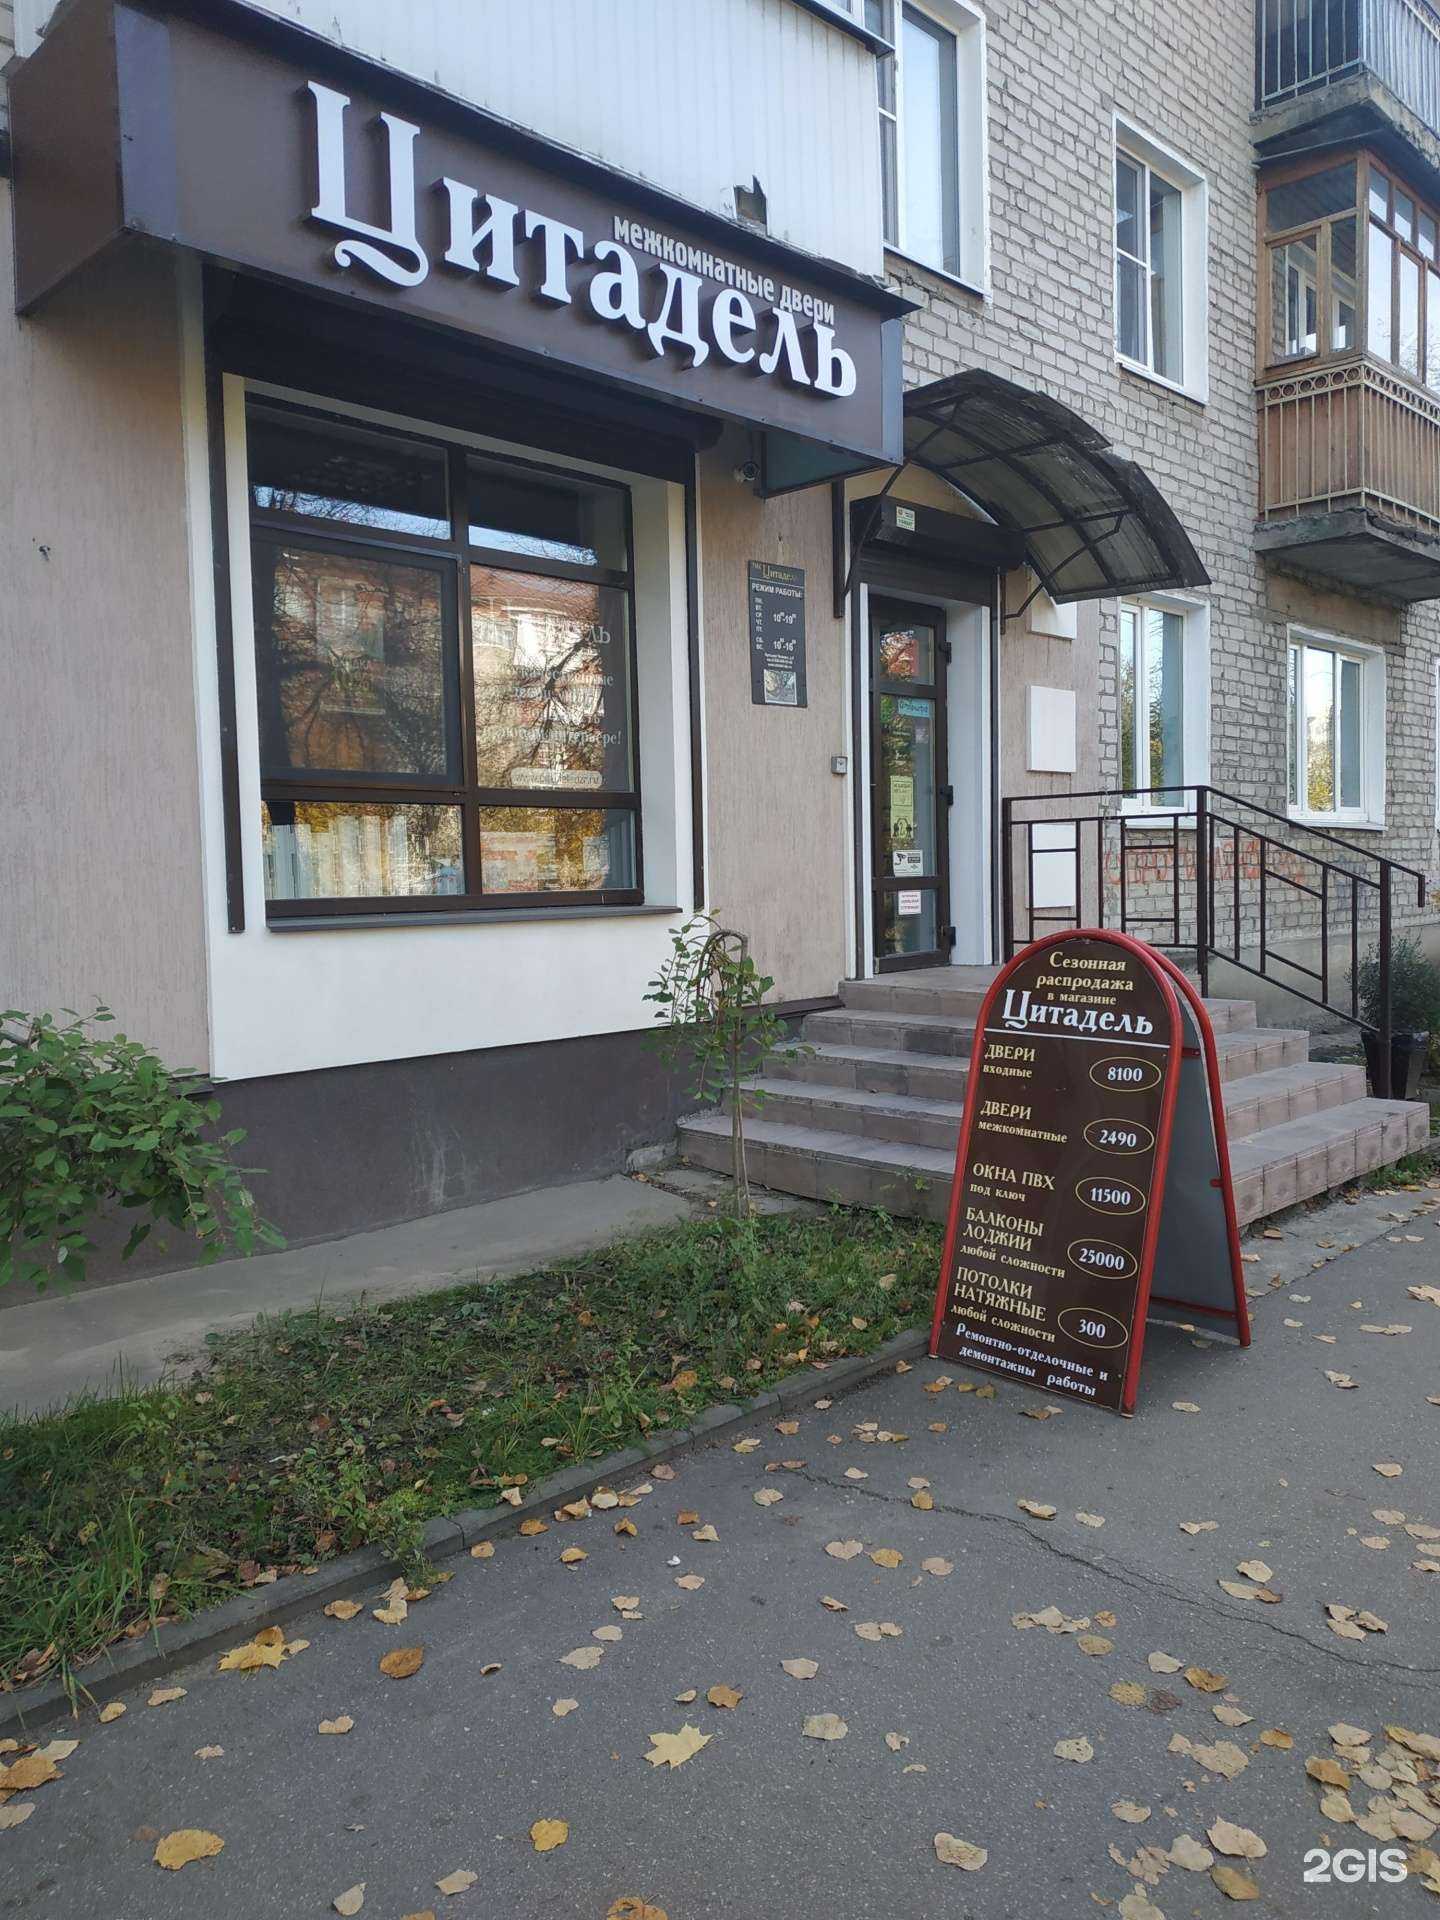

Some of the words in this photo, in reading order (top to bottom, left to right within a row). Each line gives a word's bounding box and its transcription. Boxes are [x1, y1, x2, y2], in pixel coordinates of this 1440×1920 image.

[306, 80, 857, 398] Цитадель
[613, 215, 775, 301] межкомнатные
[780, 285, 835, 325] двери
[1049, 951, 1126, 972] Сезонная
[1036, 974, 1134, 991] распродажа
[1047, 992, 1054, 1001] в
[1059, 993, 1116, 1006] магазине
[1002, 989, 1153, 1035] Цитадель
[984, 1044, 1035, 1062] ДВЕРИ
[983, 1064, 1032, 1079] входные
[1107, 1067, 1143, 1082] 8100
[980, 1100, 1031, 1120] ДВЕРИ
[978, 1120, 1067, 1143] межкомнатные
[1100, 1130, 1136, 1147] 2490
[972, 1162, 1016, 1184] ОКНА
[1022, 1170, 1055, 1190] ПВХ
[970, 1182, 991, 1197] под
[995, 1188, 1026, 1202] ключ
[1090, 1187, 1131, 1205] 11500
[966, 1207, 1044, 1237] БАЛКОНЫ
[963, 1224, 1032, 1252] ЛОДЖИИ
[960, 1244, 996, 1262] любой
[1000, 1253, 1066, 1279] сложности
[1078, 1247, 1125, 1271] 25000
[957, 1267, 1033, 1299] ПОТОЛКИ
[954, 1284, 1046, 1322] НАТЯЖНЫЕ
[951, 1304, 987, 1324] любой
[991, 1316, 1056, 1343] сложности
[1078, 1318, 1106, 1339] 300
[956, 1322, 1093, 1377] Ремонтно-отделочные
[1100, 1370, 1108, 1382] и
[1046, 1374, 1096, 1397] работы
